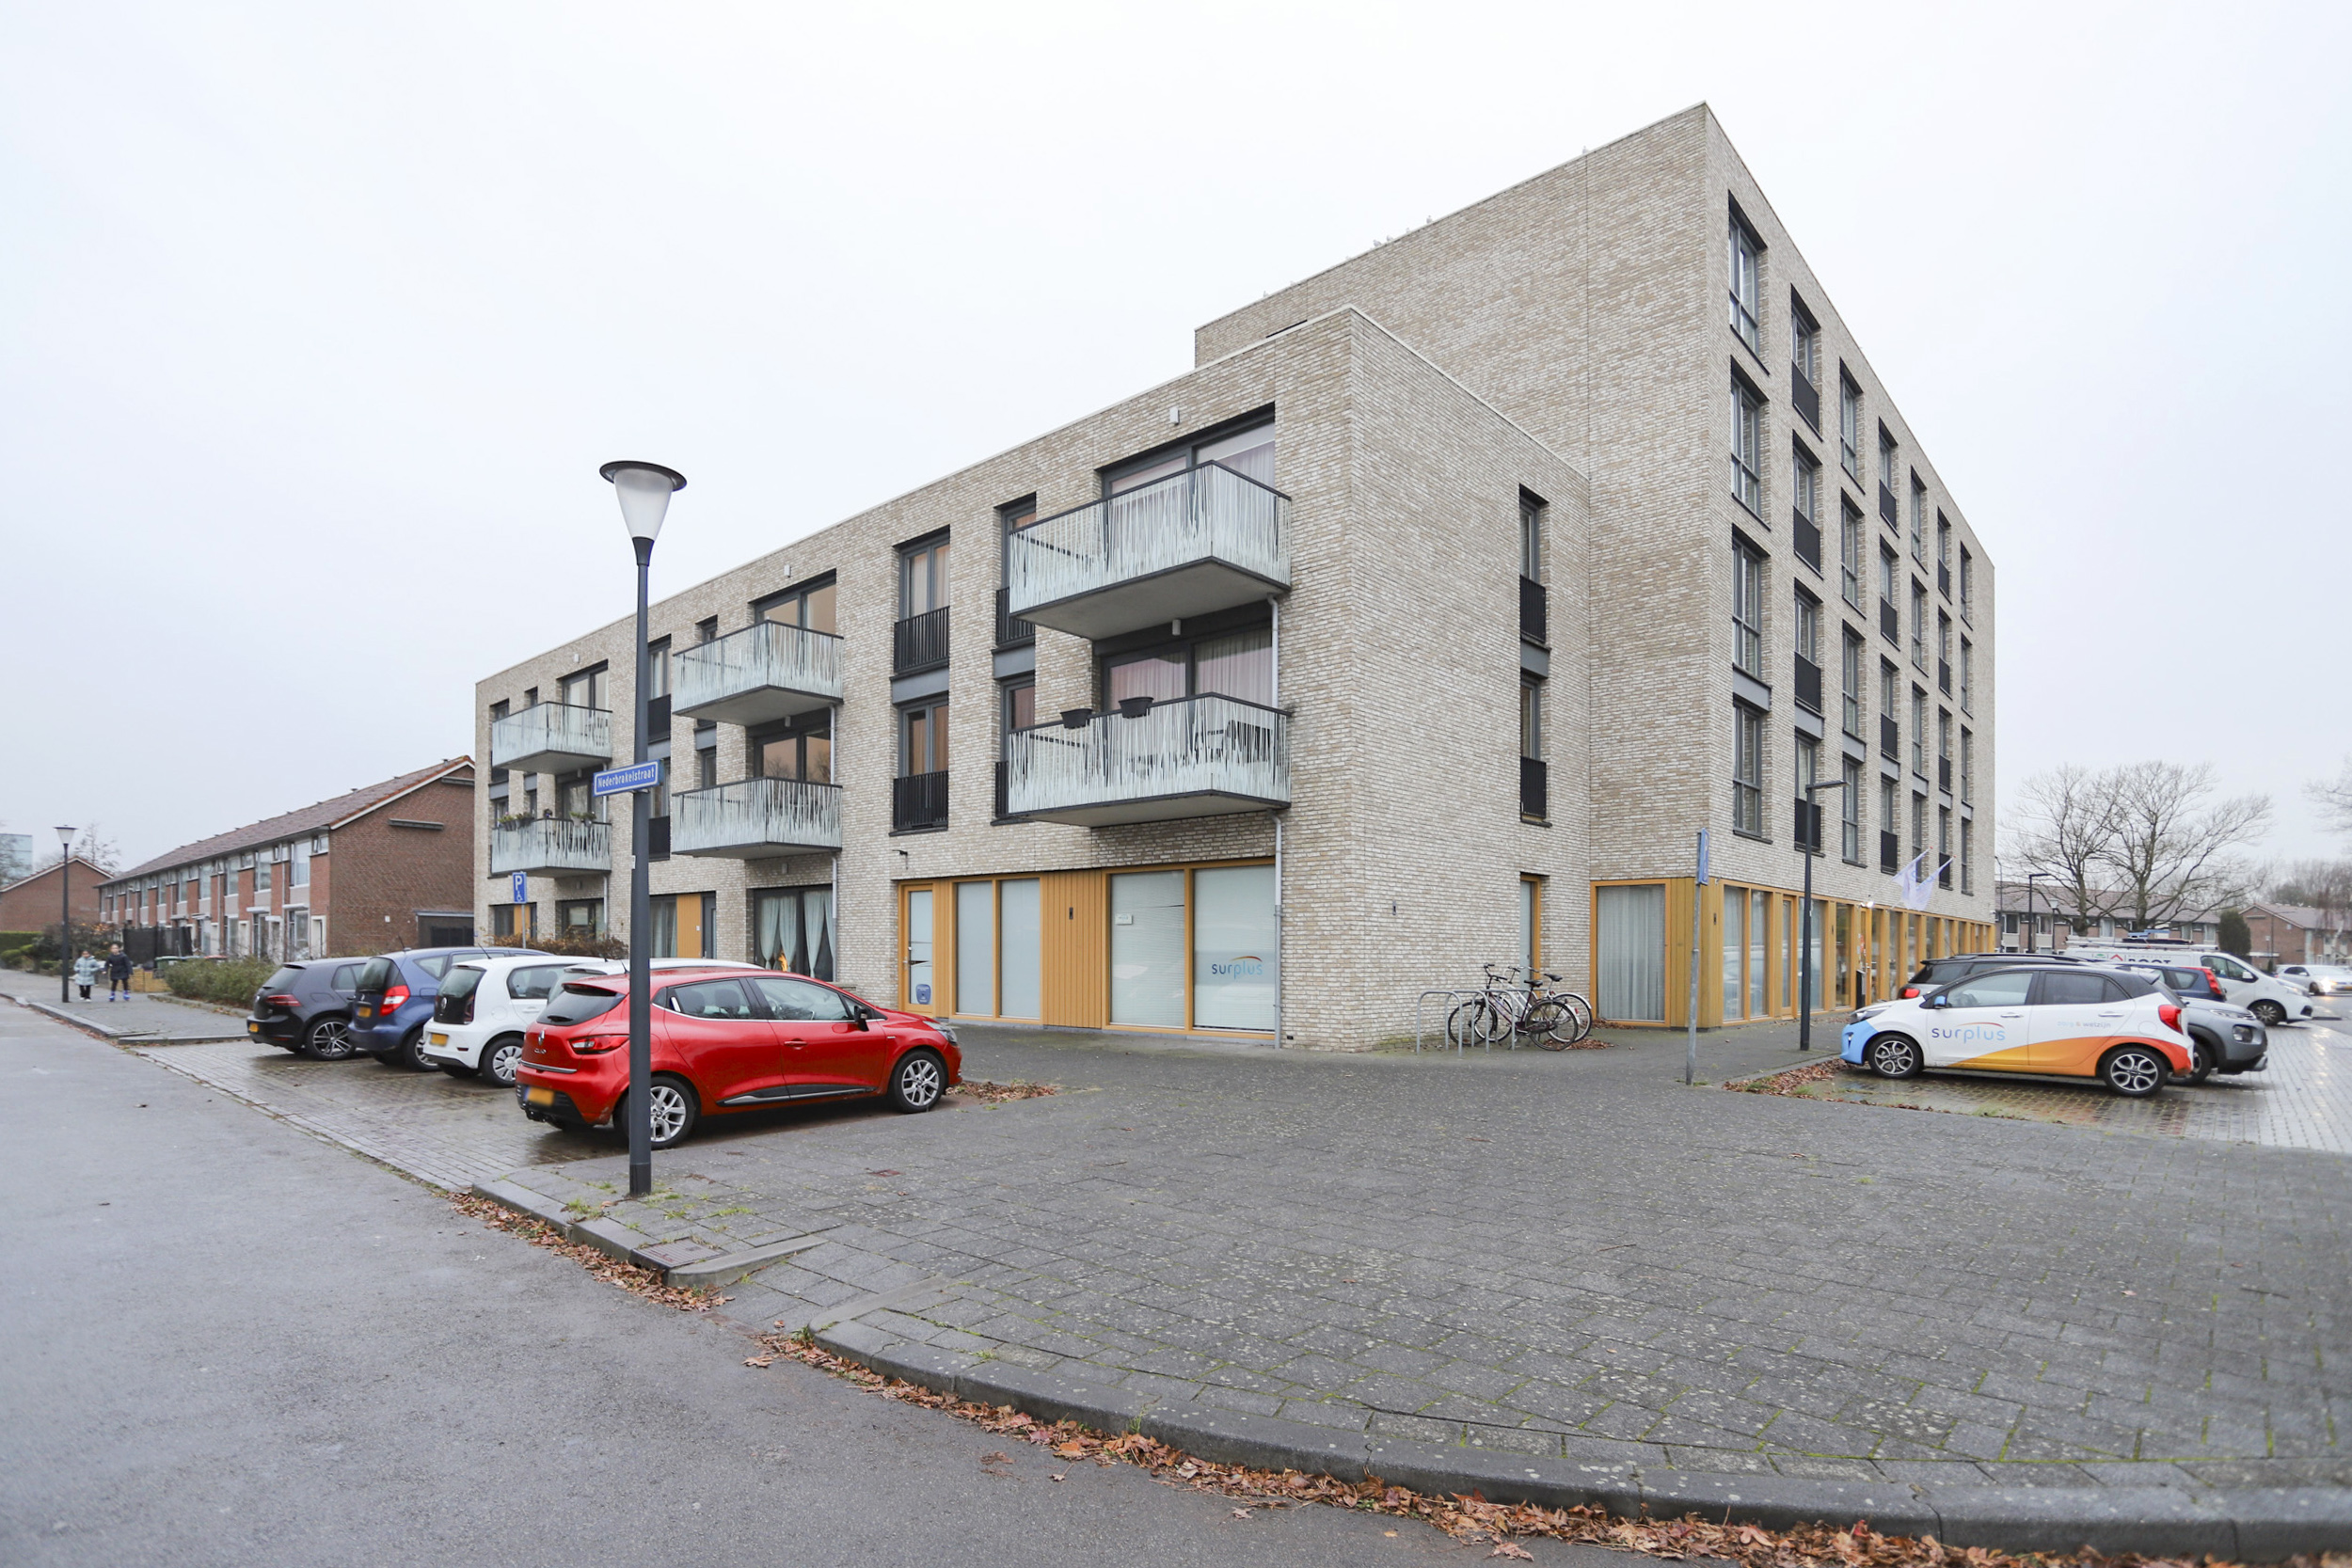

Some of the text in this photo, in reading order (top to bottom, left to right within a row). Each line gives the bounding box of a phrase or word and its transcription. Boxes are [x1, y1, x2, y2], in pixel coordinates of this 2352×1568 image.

[597, 766, 655, 788] Nederbrakelstraat
[515, 875, 523, 891] P
[1211, 960, 1263, 979] surplus
[1931, 1025, 2006, 1044] surplus
